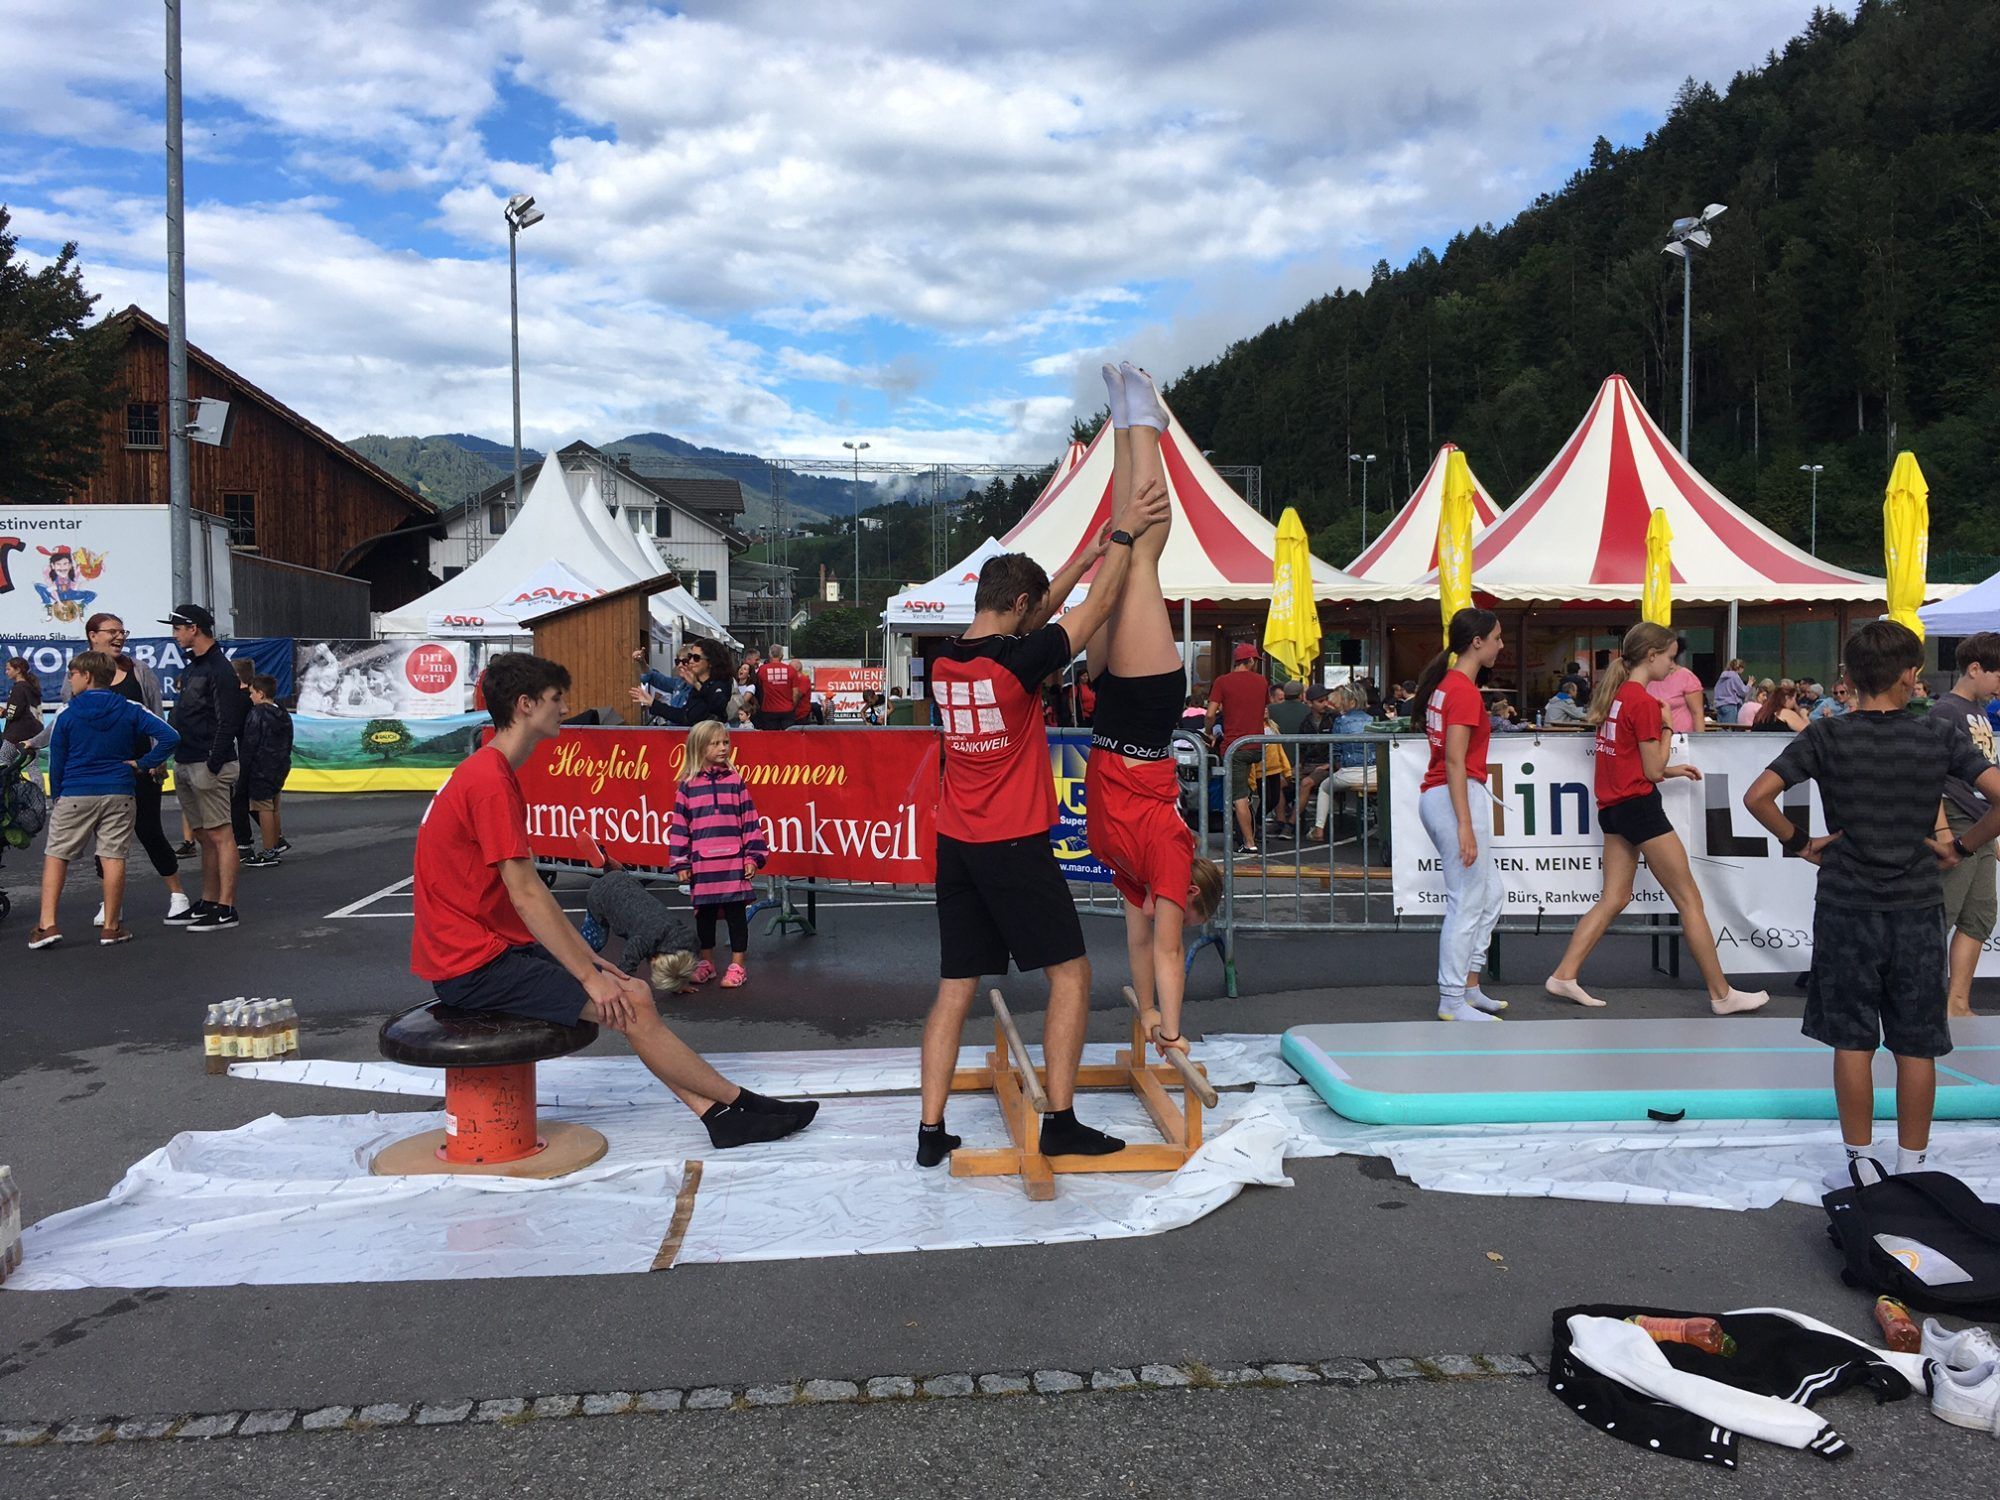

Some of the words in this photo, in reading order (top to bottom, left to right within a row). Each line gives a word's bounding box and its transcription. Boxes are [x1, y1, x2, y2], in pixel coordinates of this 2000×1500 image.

[419, 650, 443, 666] pri
[429, 663, 453, 673] ma
[413, 673, 446, 683] vera
[548, 741, 651, 795] Herzlich
[759, 801, 922, 861] ankweil
[1059, 863, 1102, 874] w.maro.at
[1535, 857, 1592, 870] MEINE
[1507, 891, 1543, 905] Bürs,
[1545, 891, 1603, 903] Rankwe
